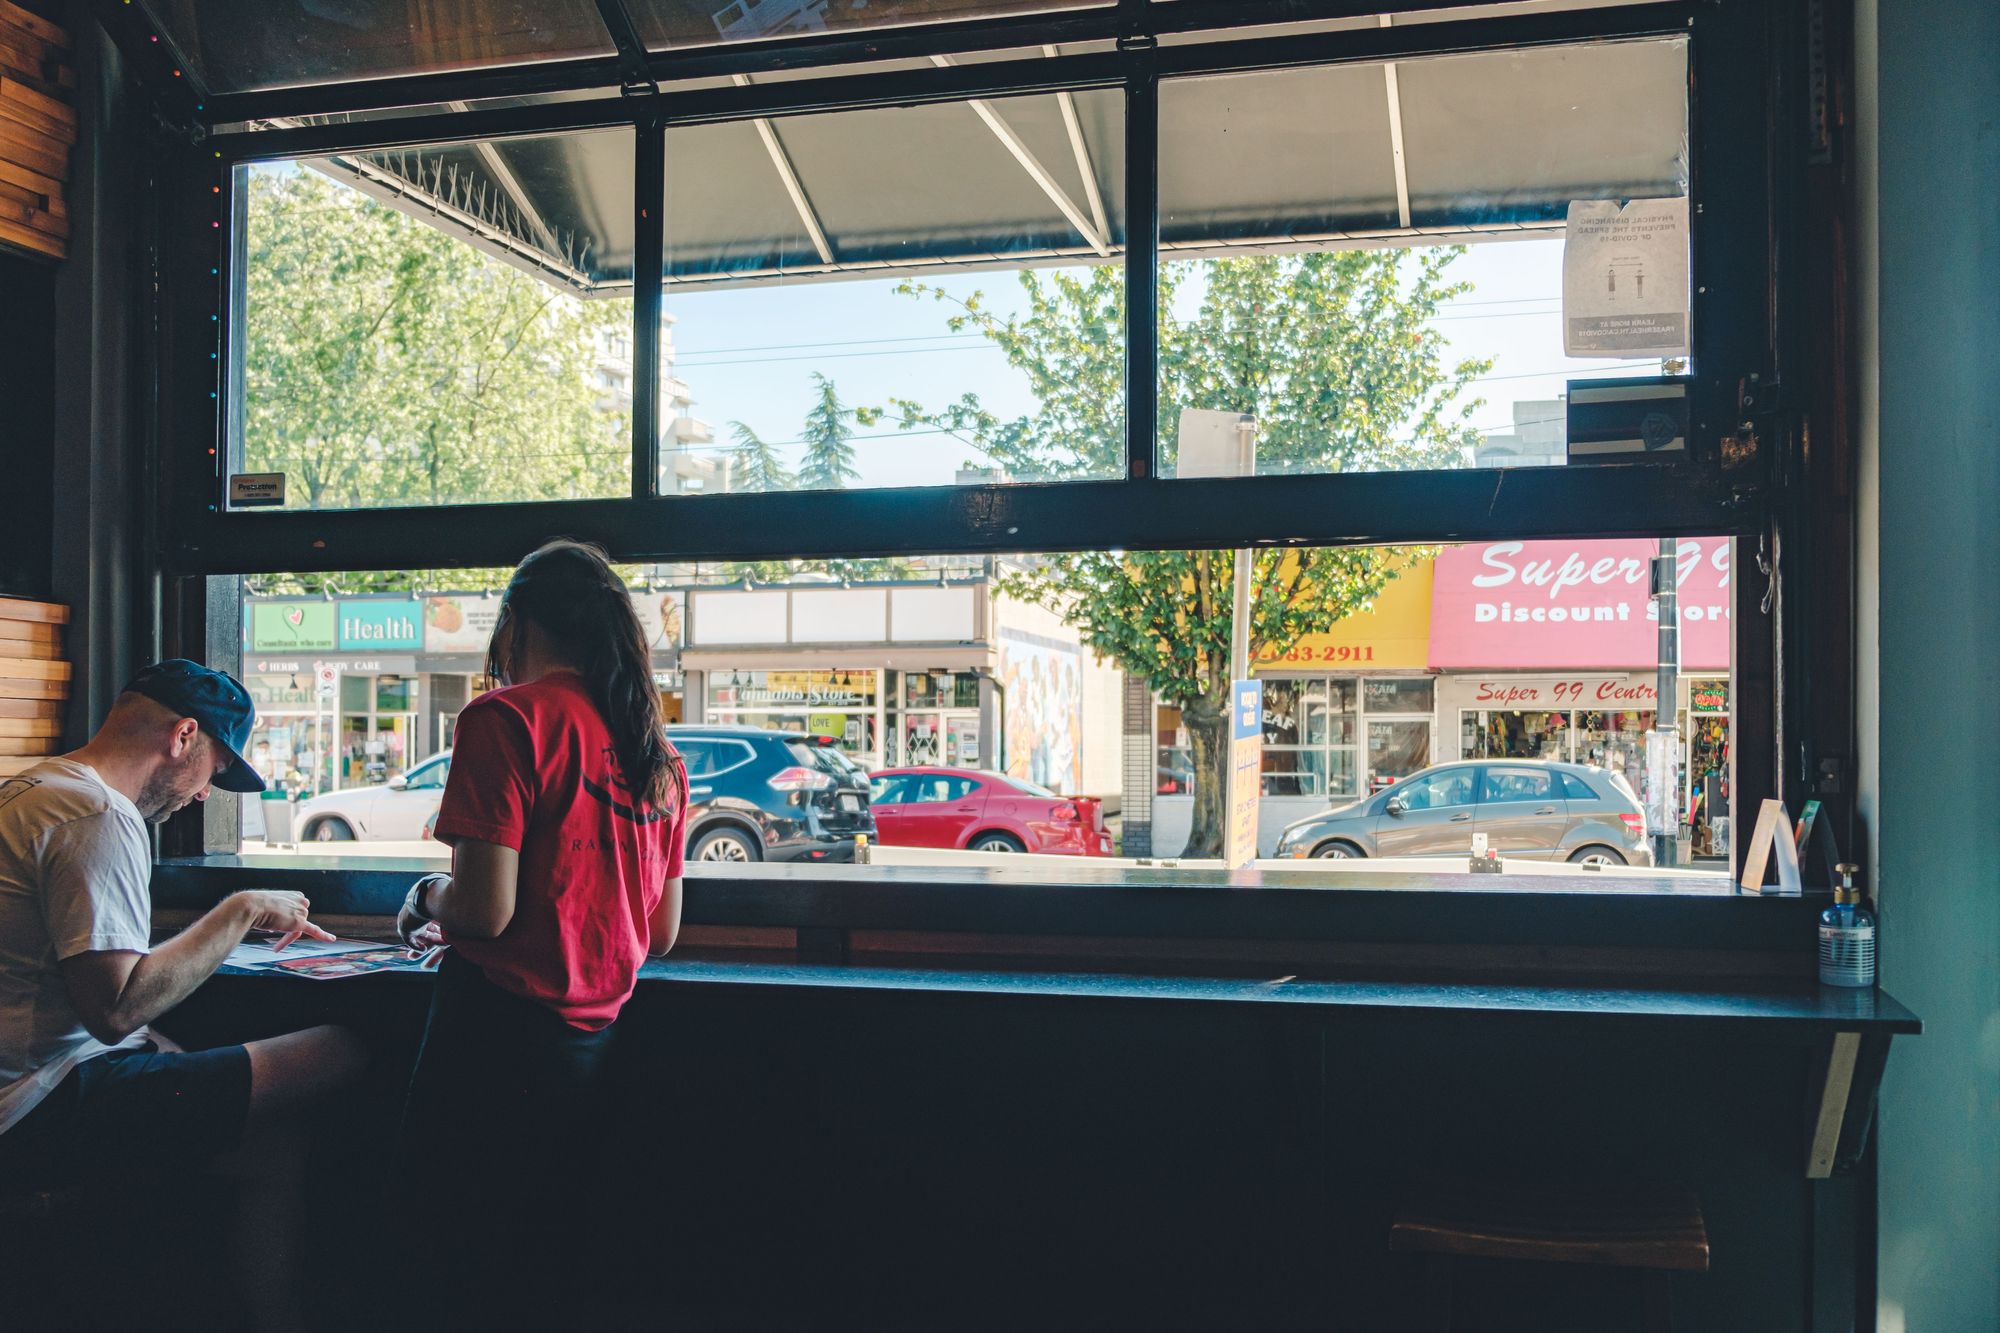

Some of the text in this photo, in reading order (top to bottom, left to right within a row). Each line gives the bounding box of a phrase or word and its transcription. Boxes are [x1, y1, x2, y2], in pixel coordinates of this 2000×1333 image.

[1472, 541, 1646, 599] Super
[1475, 600, 1729, 622] Discount Sor
[343, 616, 414, 640] Health
[269, 662, 299, 672] HERBS
[354, 661, 381, 671] CARE
[729, 683, 804, 701] Cannabis
[809, 684, 856, 705] Store
[1476, 682, 1539, 706] Super
[1553, 681, 1584, 701] 99
[812, 718, 830, 728] LOVE
